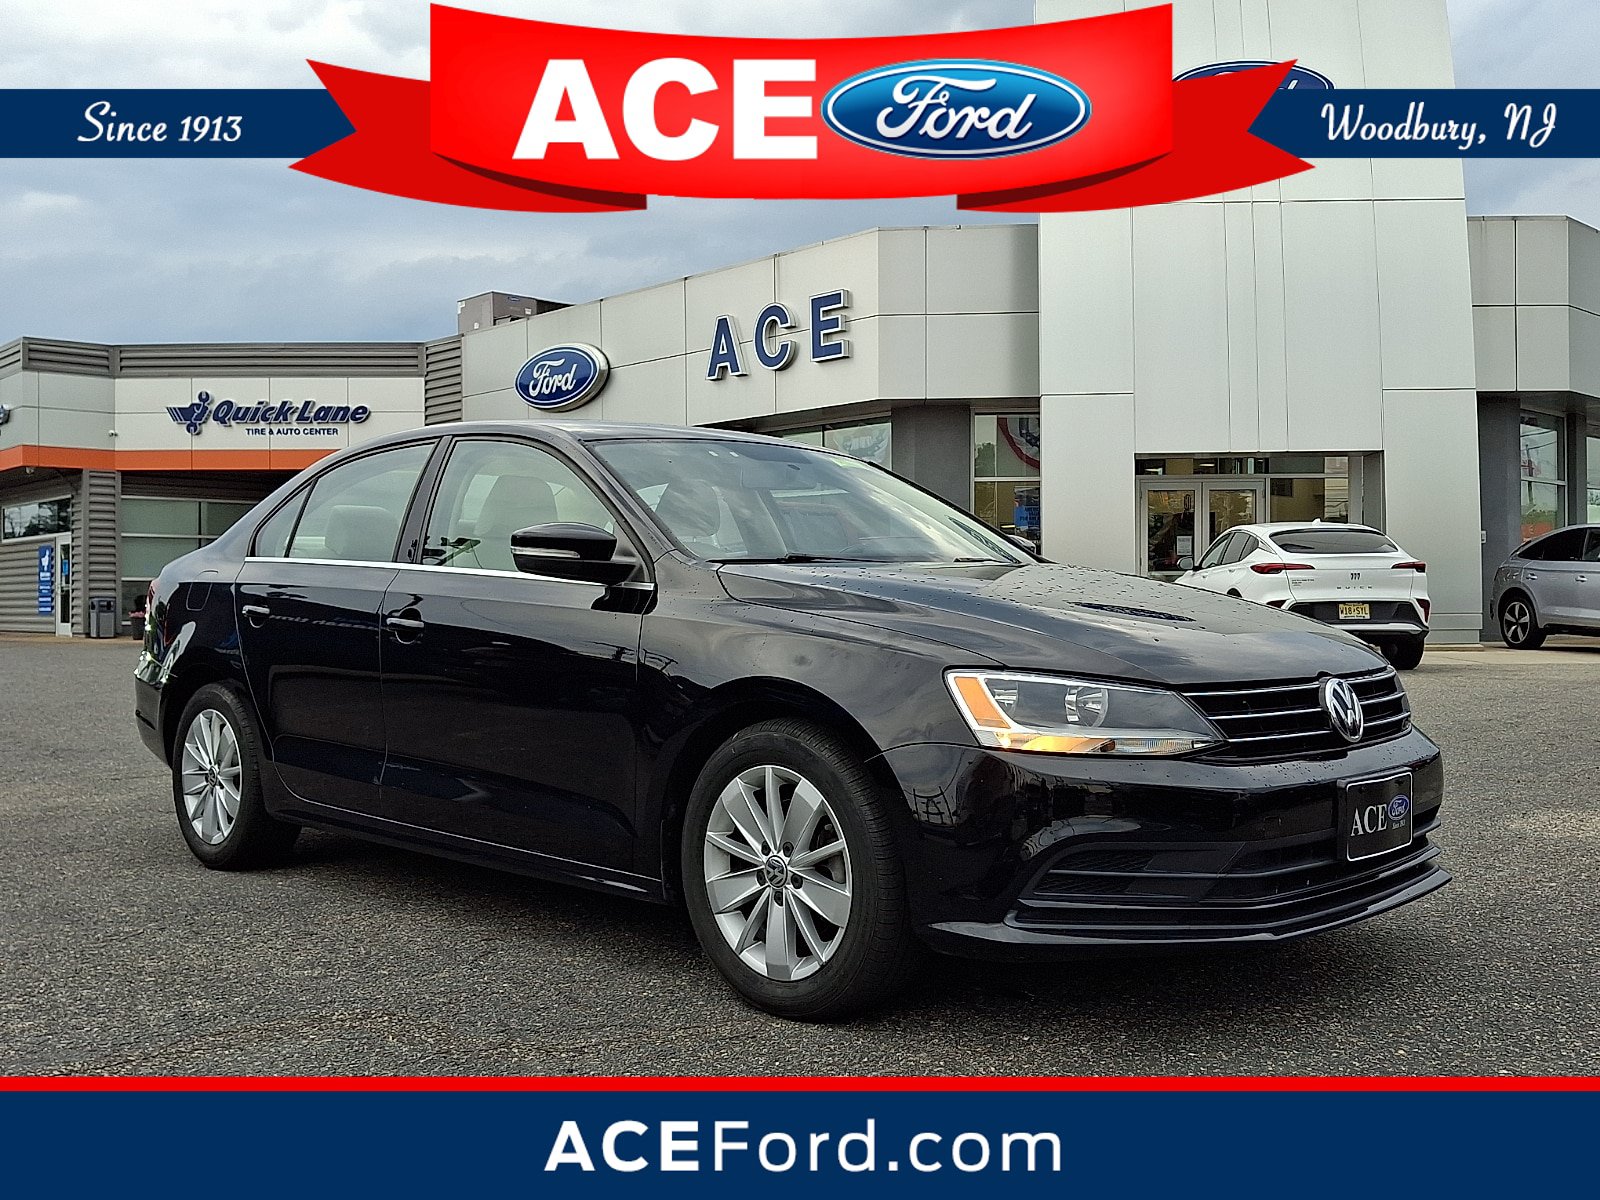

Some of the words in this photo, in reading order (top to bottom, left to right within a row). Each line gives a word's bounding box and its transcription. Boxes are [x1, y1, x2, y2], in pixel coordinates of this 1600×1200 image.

[706, 289, 850, 381] ACE
[529, 358, 577, 396] Ford
[212, 399, 295, 426] Quick
[295, 400, 370, 424] Lane
[245, 427, 267, 436] TIRE
[268, 427, 275, 436] &
[276, 427, 301, 436] AUTO
[302, 427, 339, 436] CENTER
[1350, 804, 1388, 837] ACE
